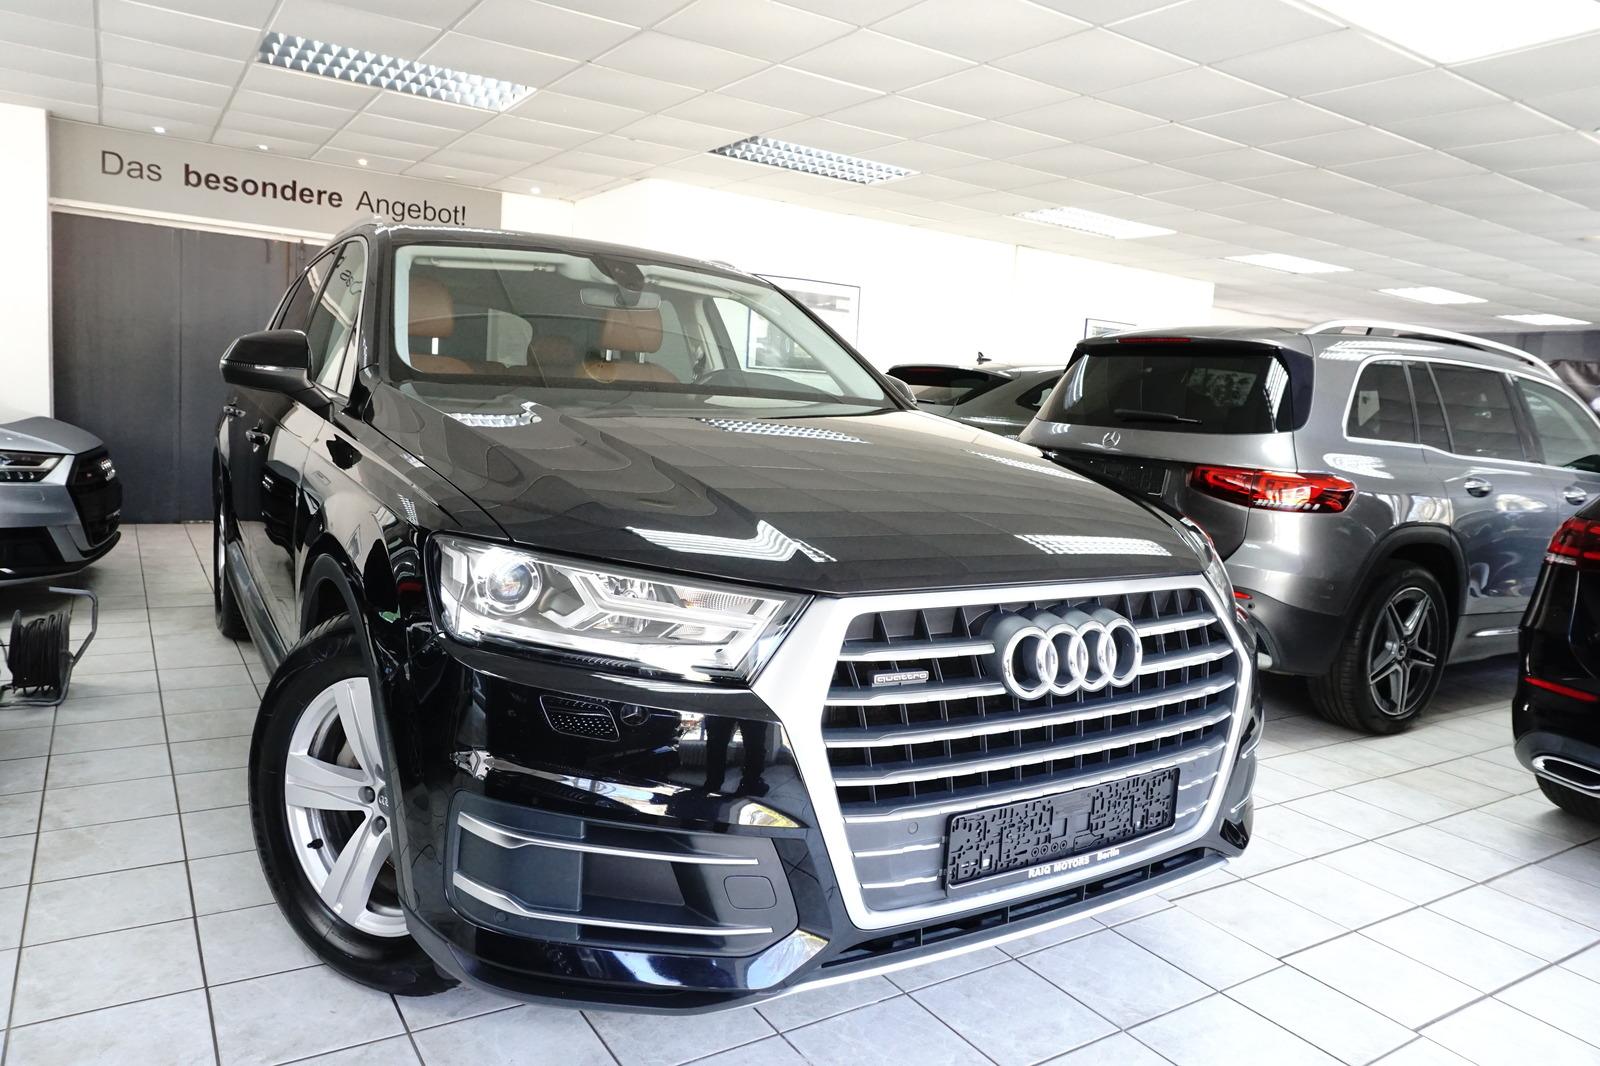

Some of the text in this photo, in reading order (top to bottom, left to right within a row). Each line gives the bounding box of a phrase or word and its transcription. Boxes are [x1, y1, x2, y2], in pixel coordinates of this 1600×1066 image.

[101, 150, 466, 226] Das besondere Angebot!
[877, 672, 927, 683] quattro
[1053, 857, 1090, 872] MOTORS
[1096, 848, 1120, 861] Berlin
